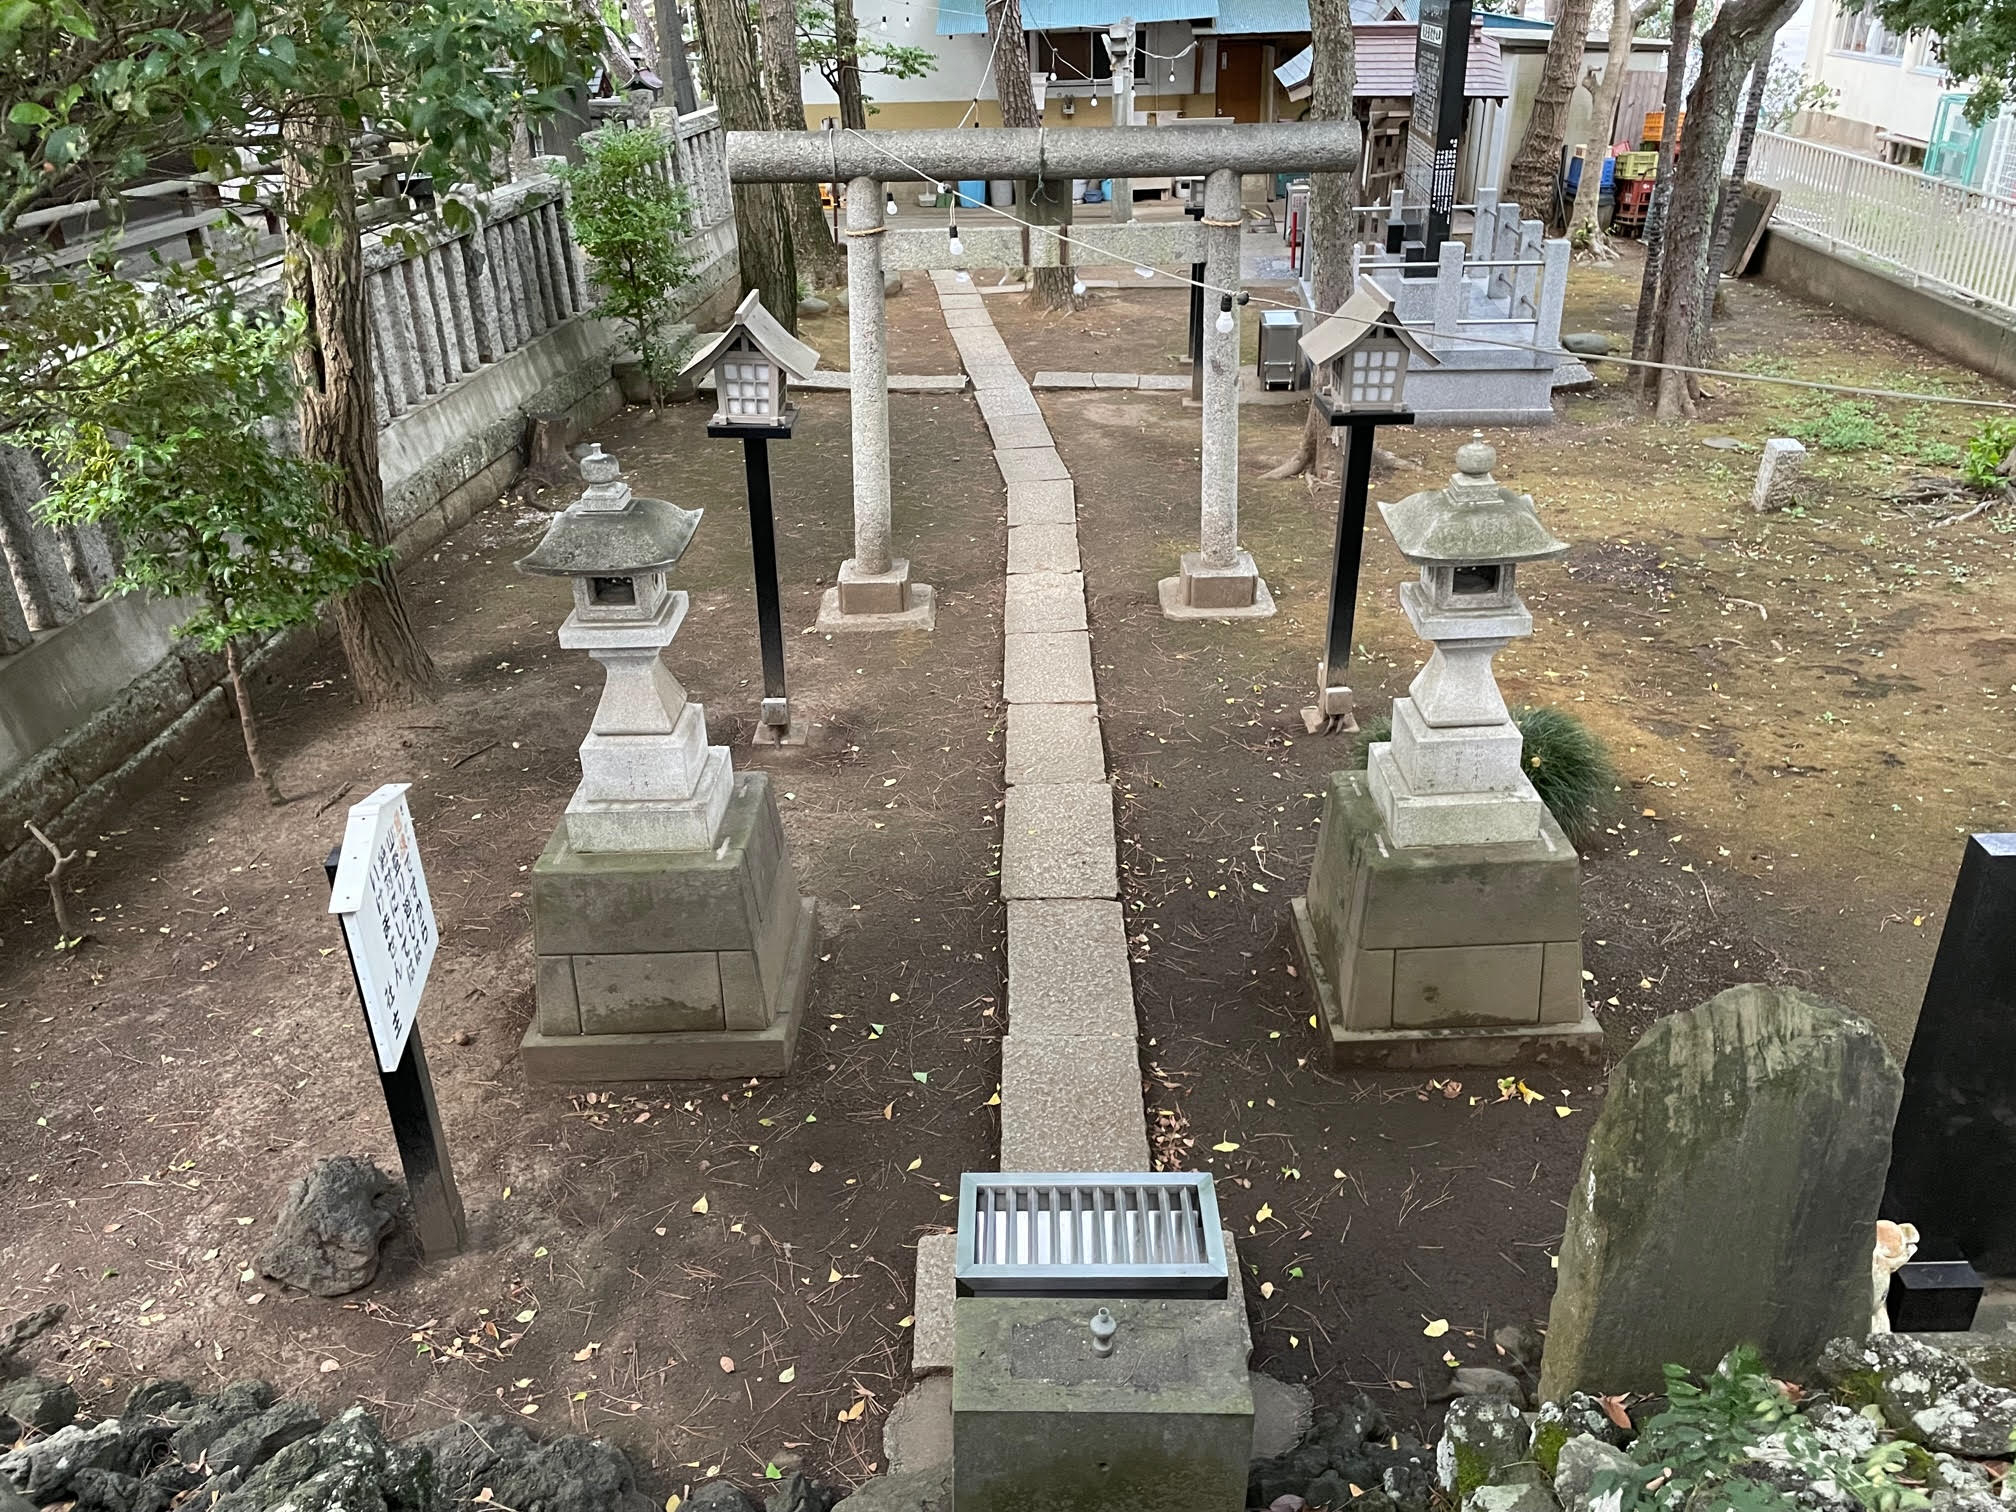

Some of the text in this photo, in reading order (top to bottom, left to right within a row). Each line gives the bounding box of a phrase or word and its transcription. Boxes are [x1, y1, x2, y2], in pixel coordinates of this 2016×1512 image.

[370, 864, 403, 987] いけません
[394, 811, 428, 945] ですから
